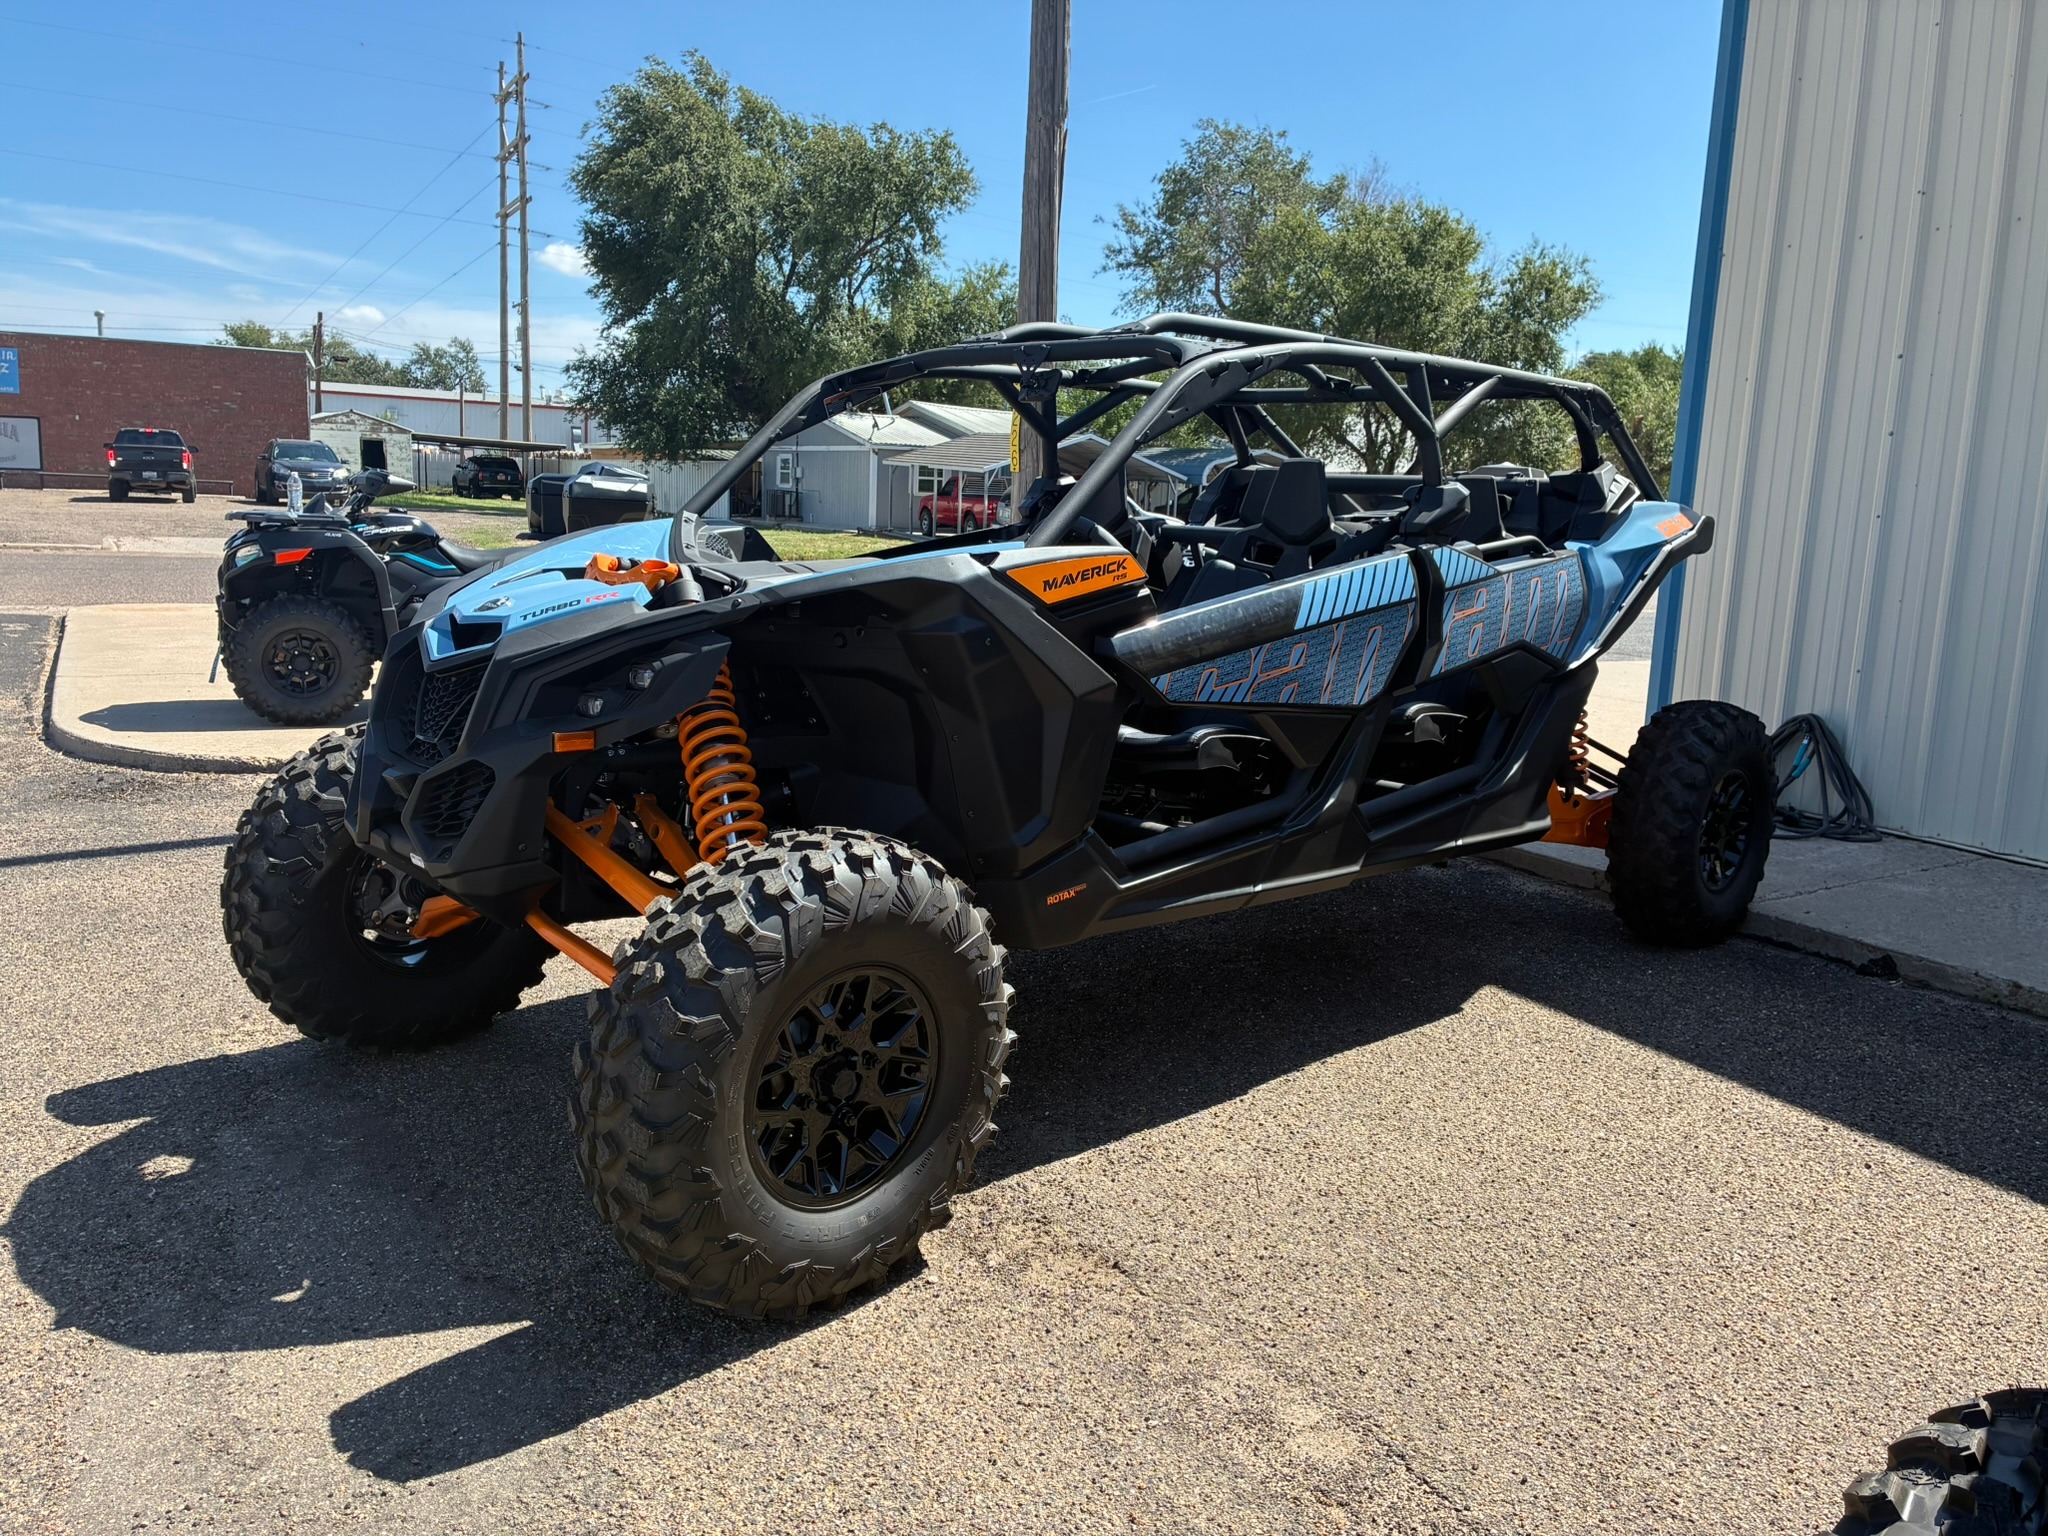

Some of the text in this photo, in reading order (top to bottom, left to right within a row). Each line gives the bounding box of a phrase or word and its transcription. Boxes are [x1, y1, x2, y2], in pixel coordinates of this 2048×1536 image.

[362, 524, 413, 537] CFORCE
[1042, 557, 1128, 593] MAVERICK
[1112, 572, 1128, 583] RS
[520, 591, 620, 621] TURBO RR
[1047, 889, 1076, 906] ROTAX
